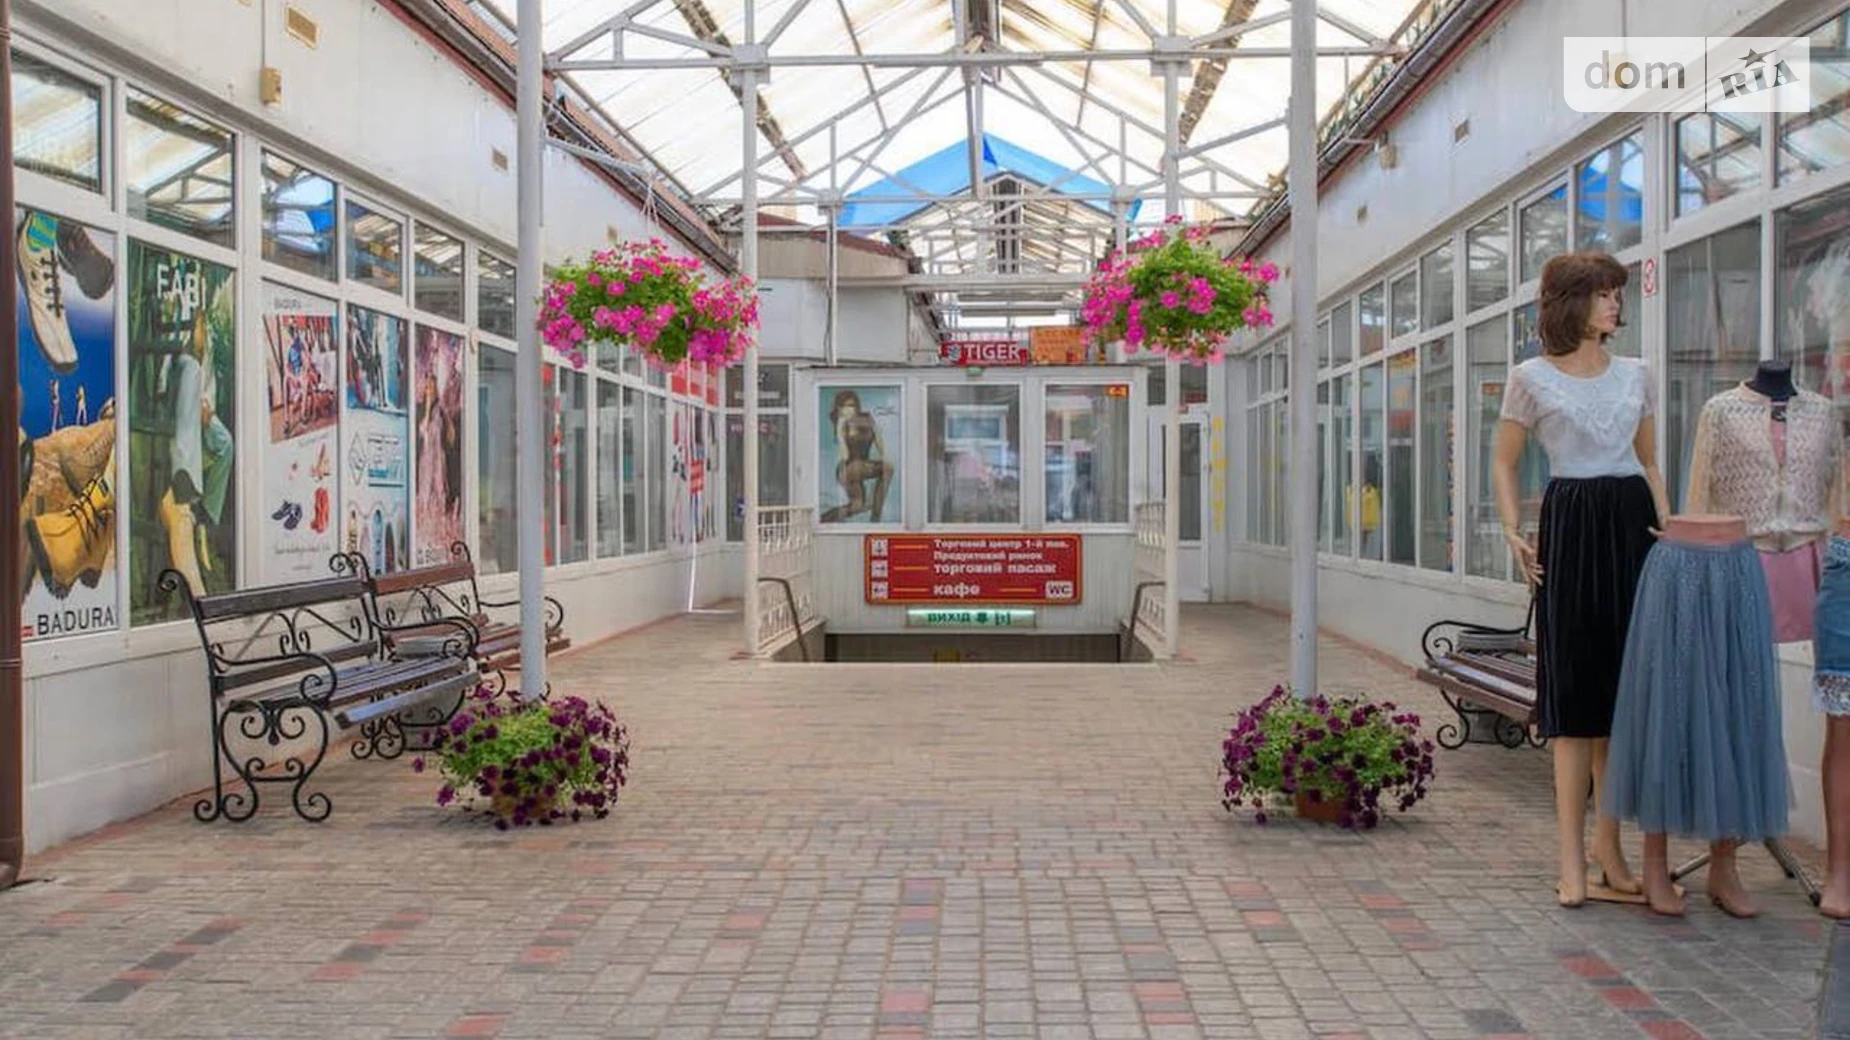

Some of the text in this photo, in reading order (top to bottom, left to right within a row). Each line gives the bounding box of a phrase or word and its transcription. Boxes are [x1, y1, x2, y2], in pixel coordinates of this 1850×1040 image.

[156, 263, 207, 312] FABI
[963, 344, 1020, 359] TIGER
[934, 562, 1057, 576] торговий пасаж
[1047, 583, 1071, 595] WC
[36, 603, 115, 636] BADURA
